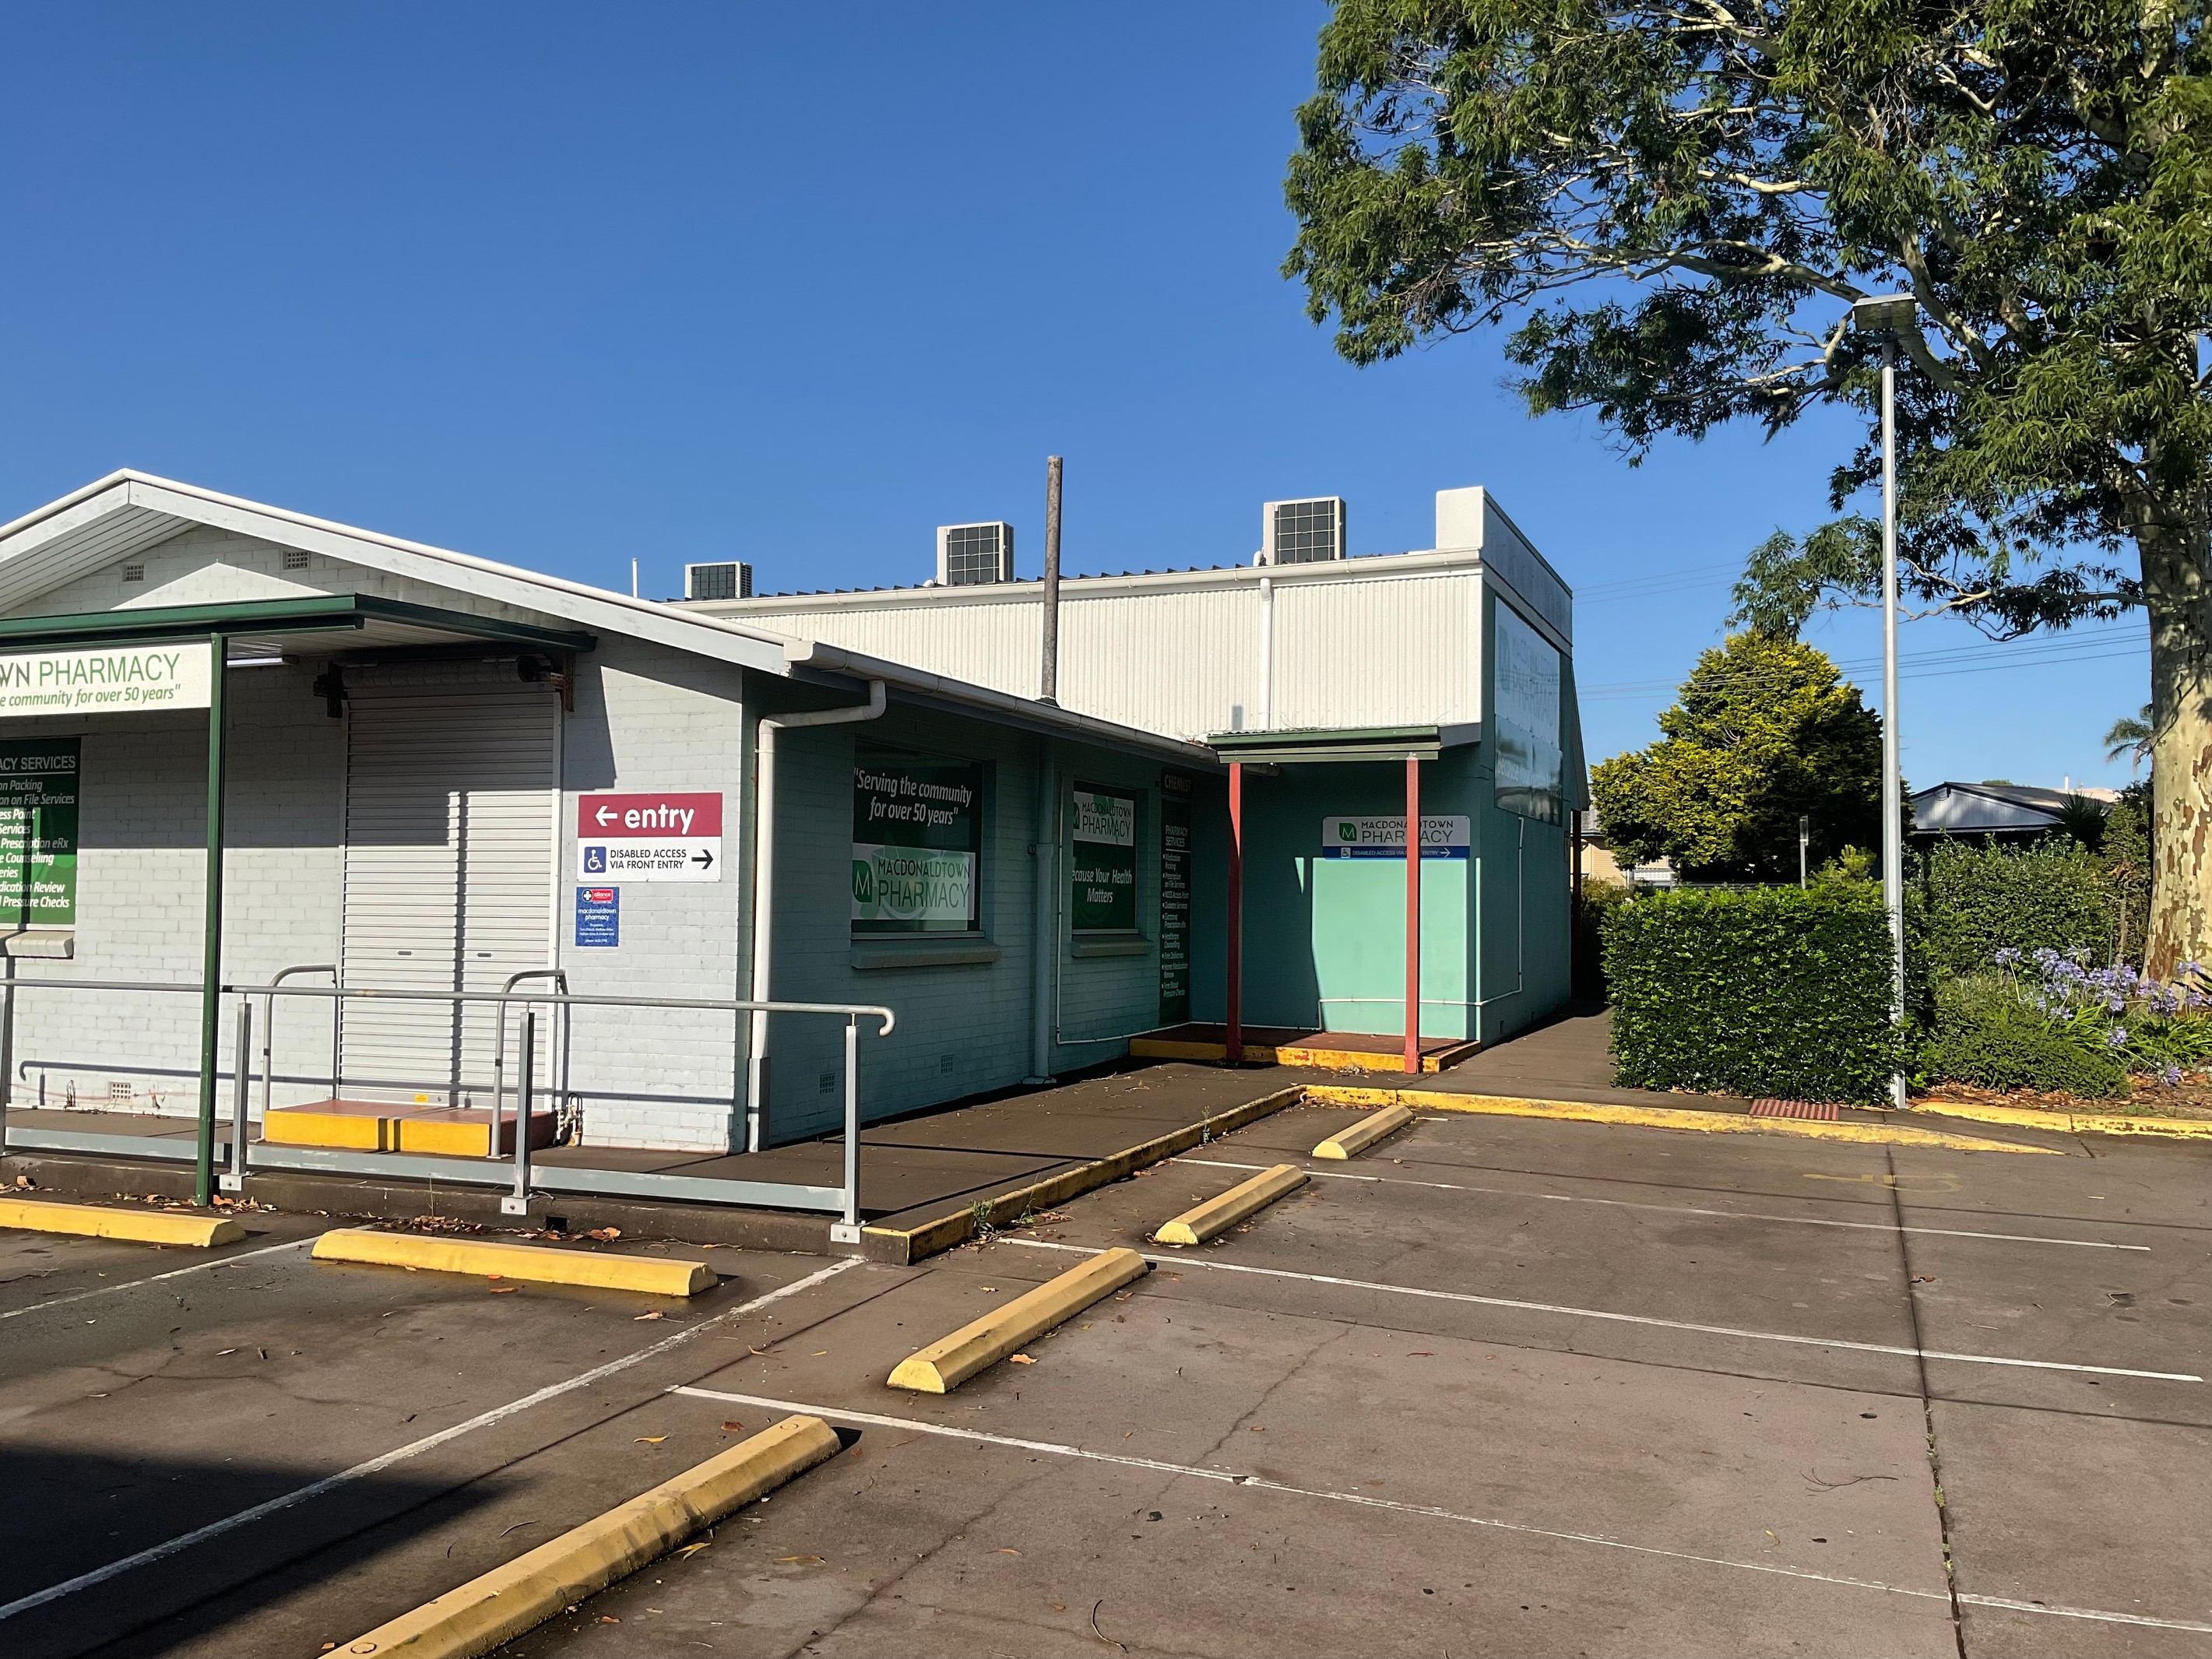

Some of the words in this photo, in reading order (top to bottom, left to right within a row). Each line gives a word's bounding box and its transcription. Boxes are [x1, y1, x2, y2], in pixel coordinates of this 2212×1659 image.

[39, 653, 181, 687] PHARMACY
[9, 690, 72, 708] community
[74, 689, 93, 707] for
[95, 691, 122, 702] over
[125, 687, 139, 701] 50
[142, 684, 181, 705] years"
[20, 755, 76, 770] SERVICES
[9, 779, 43, 793] Packing
[853, 767, 898, 797] "Serving
[900, 775, 916, 796] the
[919, 782, 972, 807] community
[1164, 775, 1191, 793] CHEMIST
[11, 796, 22, 805] on
[23, 793, 40, 805] File
[40, 793, 76, 804] Services
[12, 807, 36, 820] Point
[869, 796, 887, 821] for
[888, 804, 912, 821] over
[913, 803, 927, 821] 50
[927, 807, 958, 827] years"
[1081, 801, 1131, 818] MACDONALDTOWN
[624, 803, 695, 835] entry
[1082, 815, 1131, 838] PHARMACY
[1165, 824, 1188, 836] PHARMACY
[1363, 830, 1454, 843] PHARACY
[1, 837, 51, 852] Prescription
[52, 838, 69, 849] eRx
[1165, 836, 1185, 847] SERVICES
[5, 852, 55, 866] Counselling
[610, 849, 651, 858] DISABLED
[653, 849, 687, 858] ACCESS
[610, 860, 624, 869] VIA
[627, 860, 655, 869] FRONT
[657, 860, 684, 869] ENTRY
[878, 858, 970, 879] MACDONALDTOWN
[855, 870, 870, 896] M
[1095, 867, 1110, 883] Your
[1112, 869, 1132, 884] Health
[33, 881, 65, 893] Review
[878, 880, 970, 908] PHARMACY
[2, 896, 39, 908] Pressure
[40, 896, 69, 908] Checks
[1087, 887, 1113, 903] Matters
